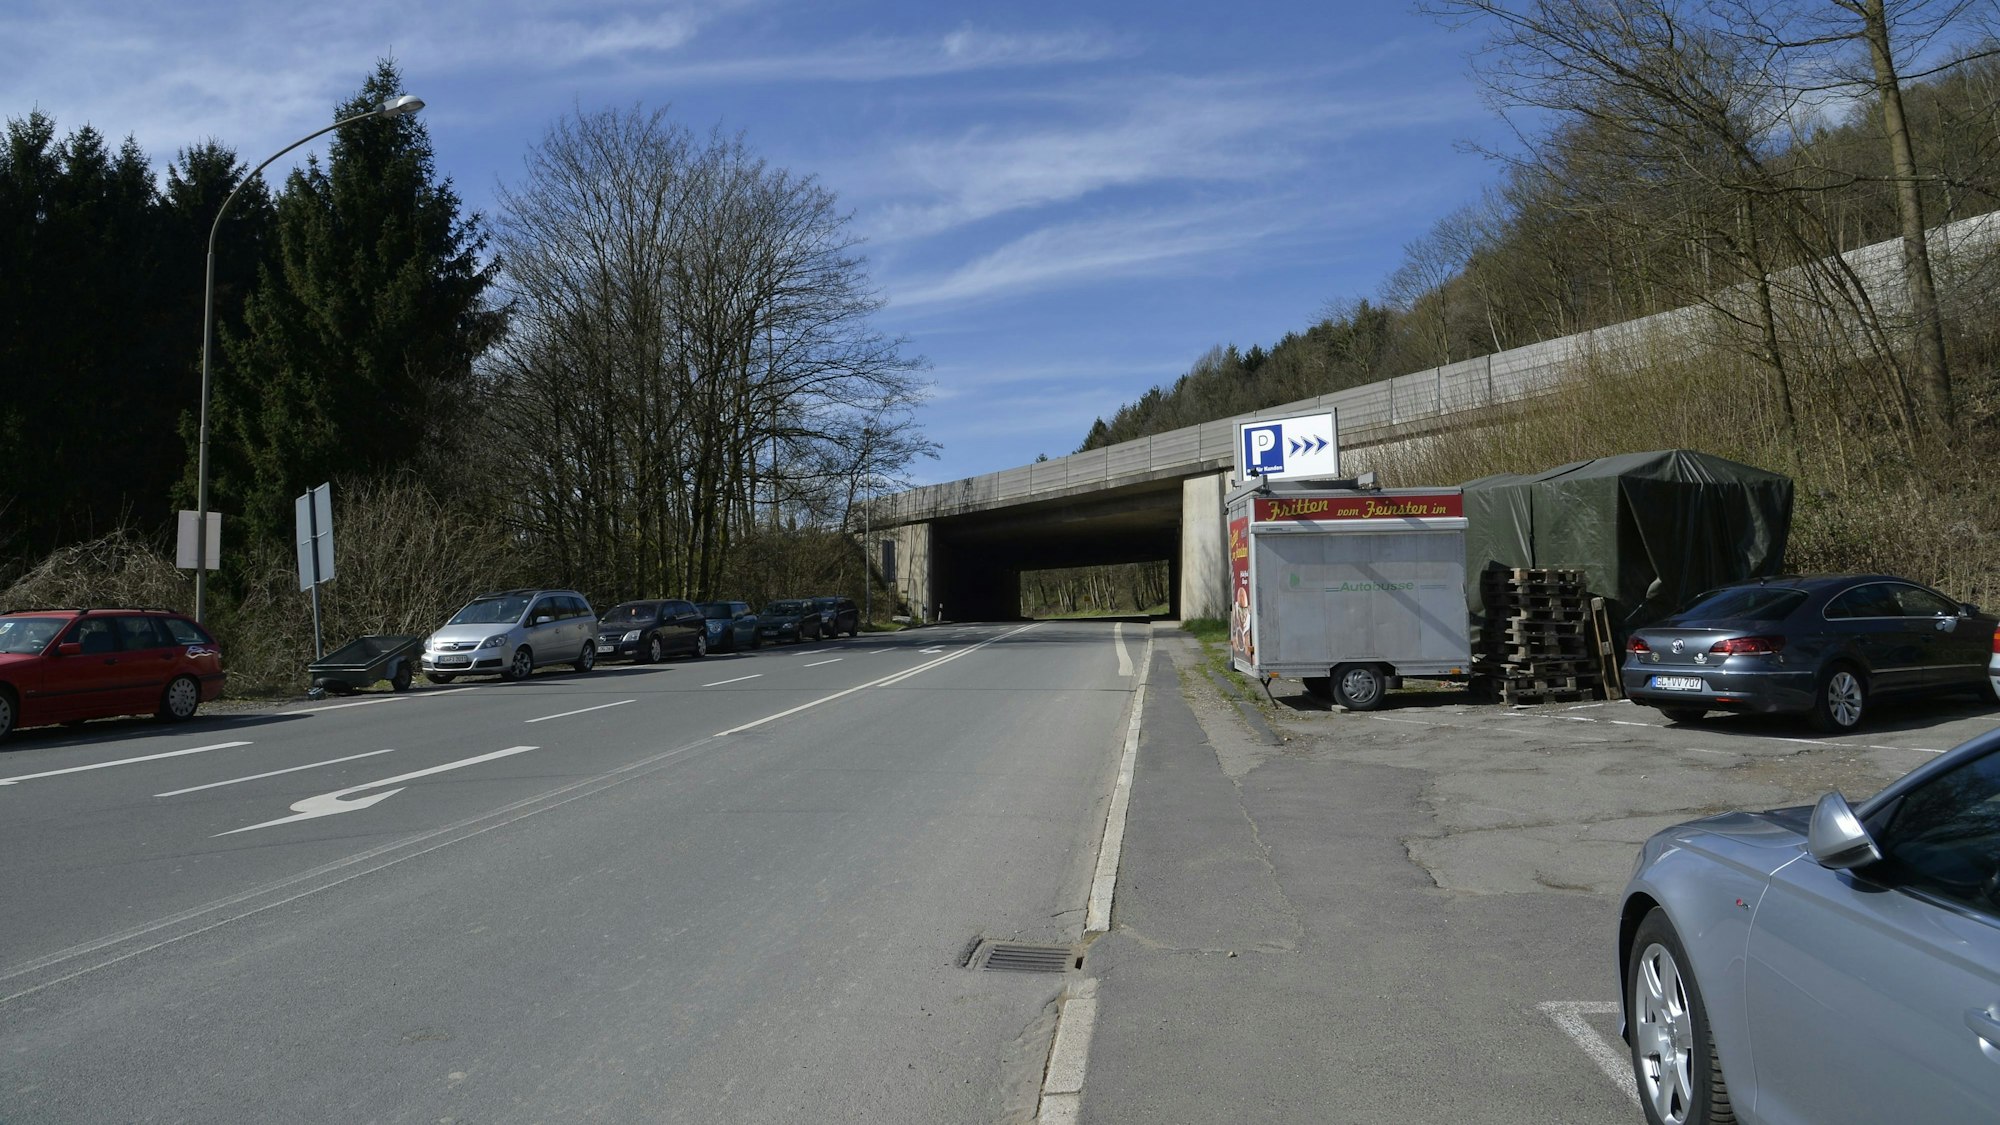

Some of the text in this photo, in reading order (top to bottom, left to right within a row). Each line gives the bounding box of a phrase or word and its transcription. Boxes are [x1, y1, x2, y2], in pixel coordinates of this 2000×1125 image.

[1251, 429, 1276, 466] P
[1266, 499, 1447, 521] Fritten vom Feinsten im
[1339, 581, 1415, 592] Autobusse
